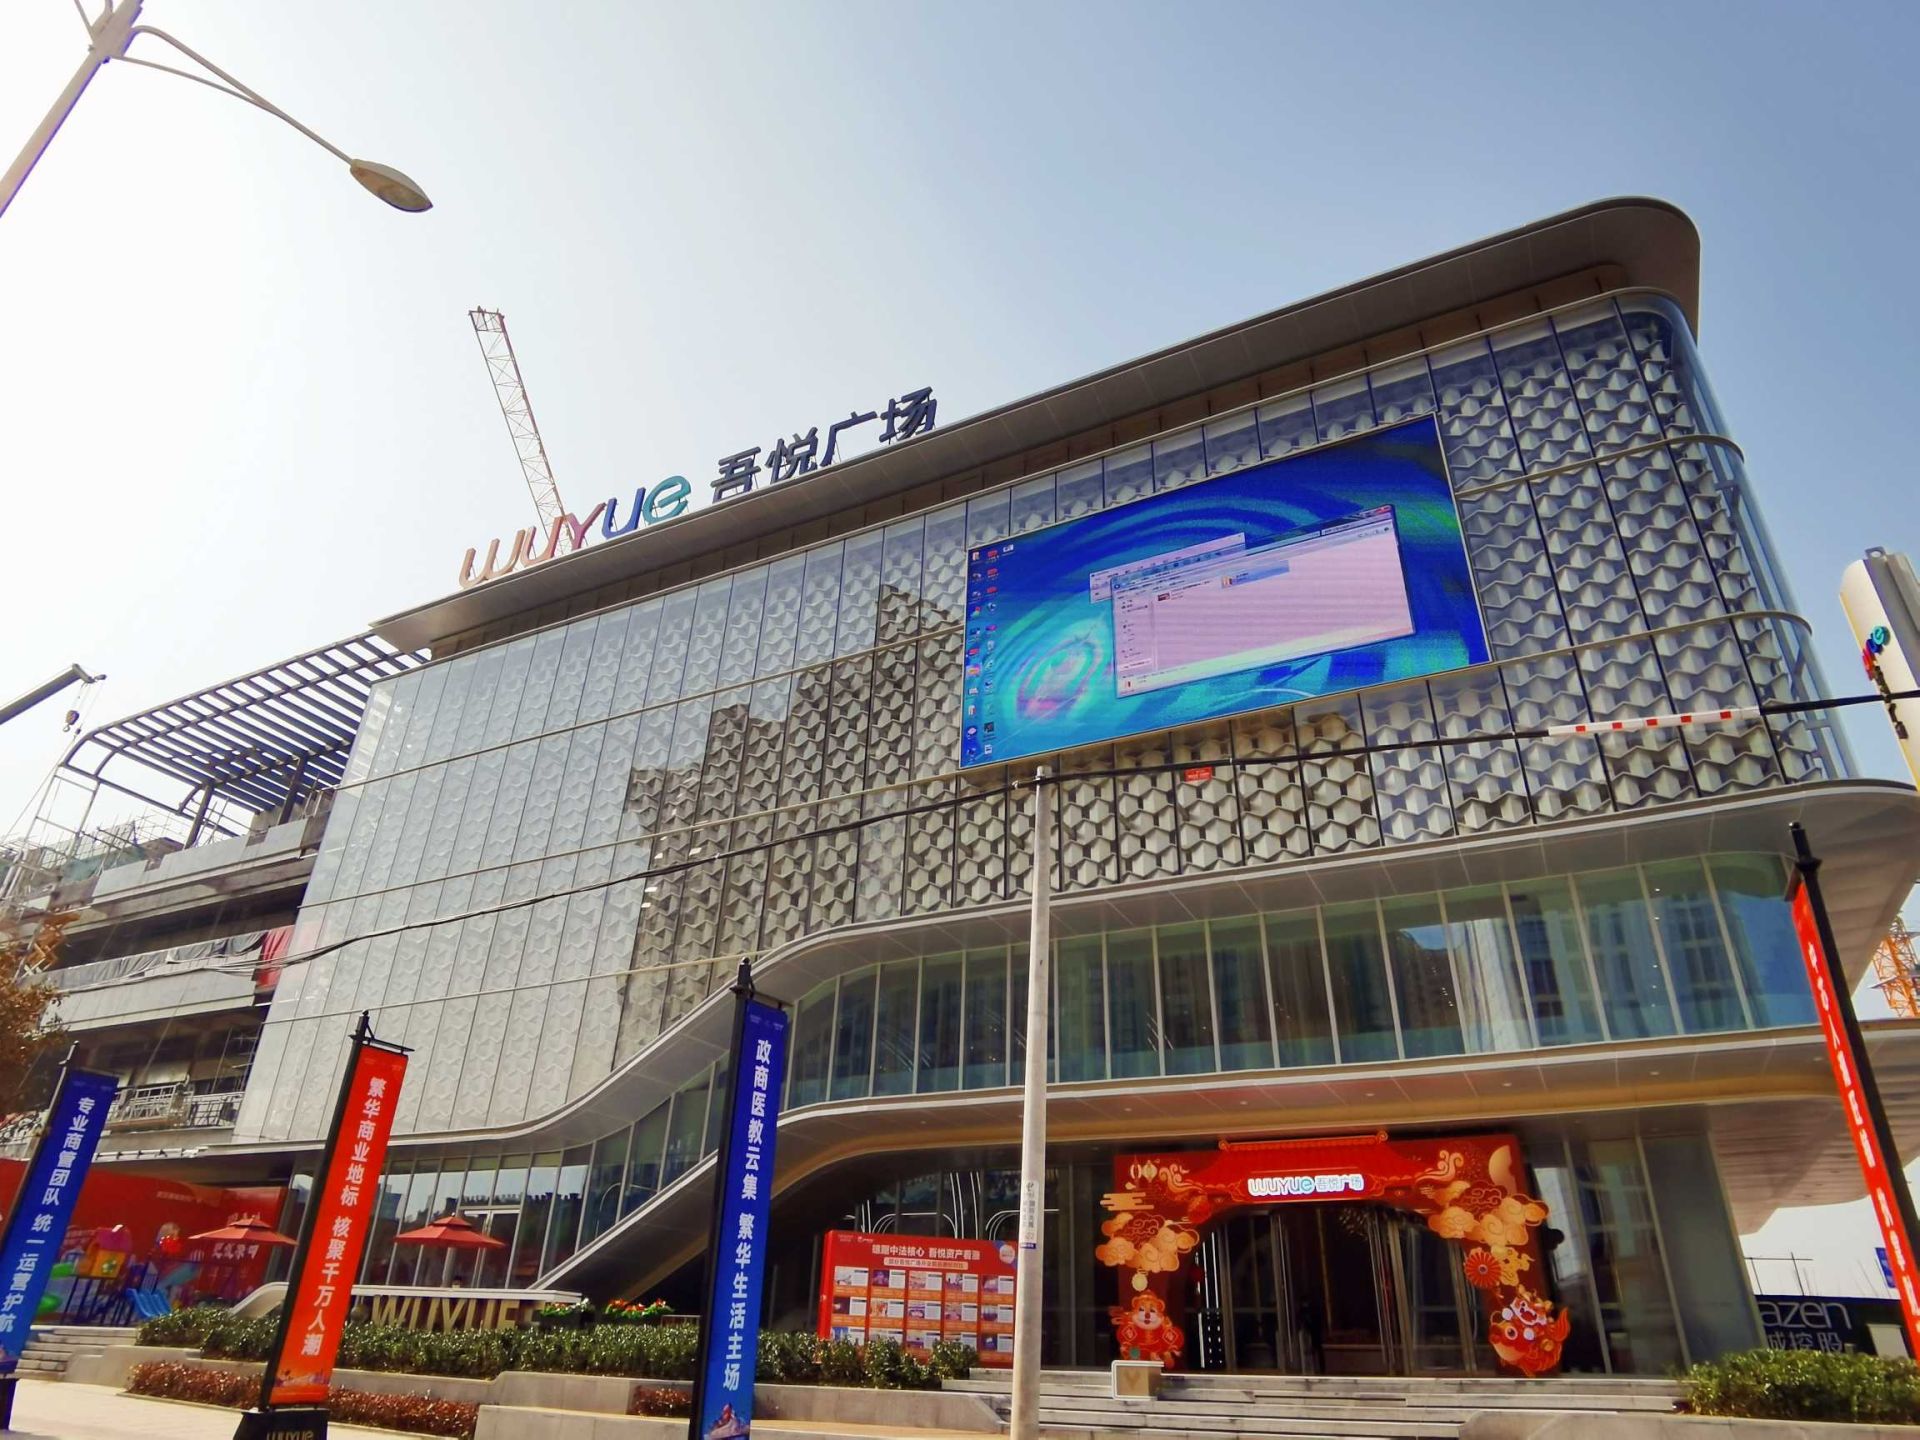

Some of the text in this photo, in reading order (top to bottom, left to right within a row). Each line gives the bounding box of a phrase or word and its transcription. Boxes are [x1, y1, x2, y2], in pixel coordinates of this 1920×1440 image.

[711, 386, 938, 503] 吾悦广场
[42, 1096, 96, 1206] 专业商管团队
[340, 1076, 386, 1207] 繁华商业地标
[740, 1038, 772, 1201] 政商医教云集
[0, 1212, 54, 1333] 统一运营护航
[301, 1216, 351, 1357] 核聚千万人潮
[722, 1212, 755, 1391] 繁华生活主场
